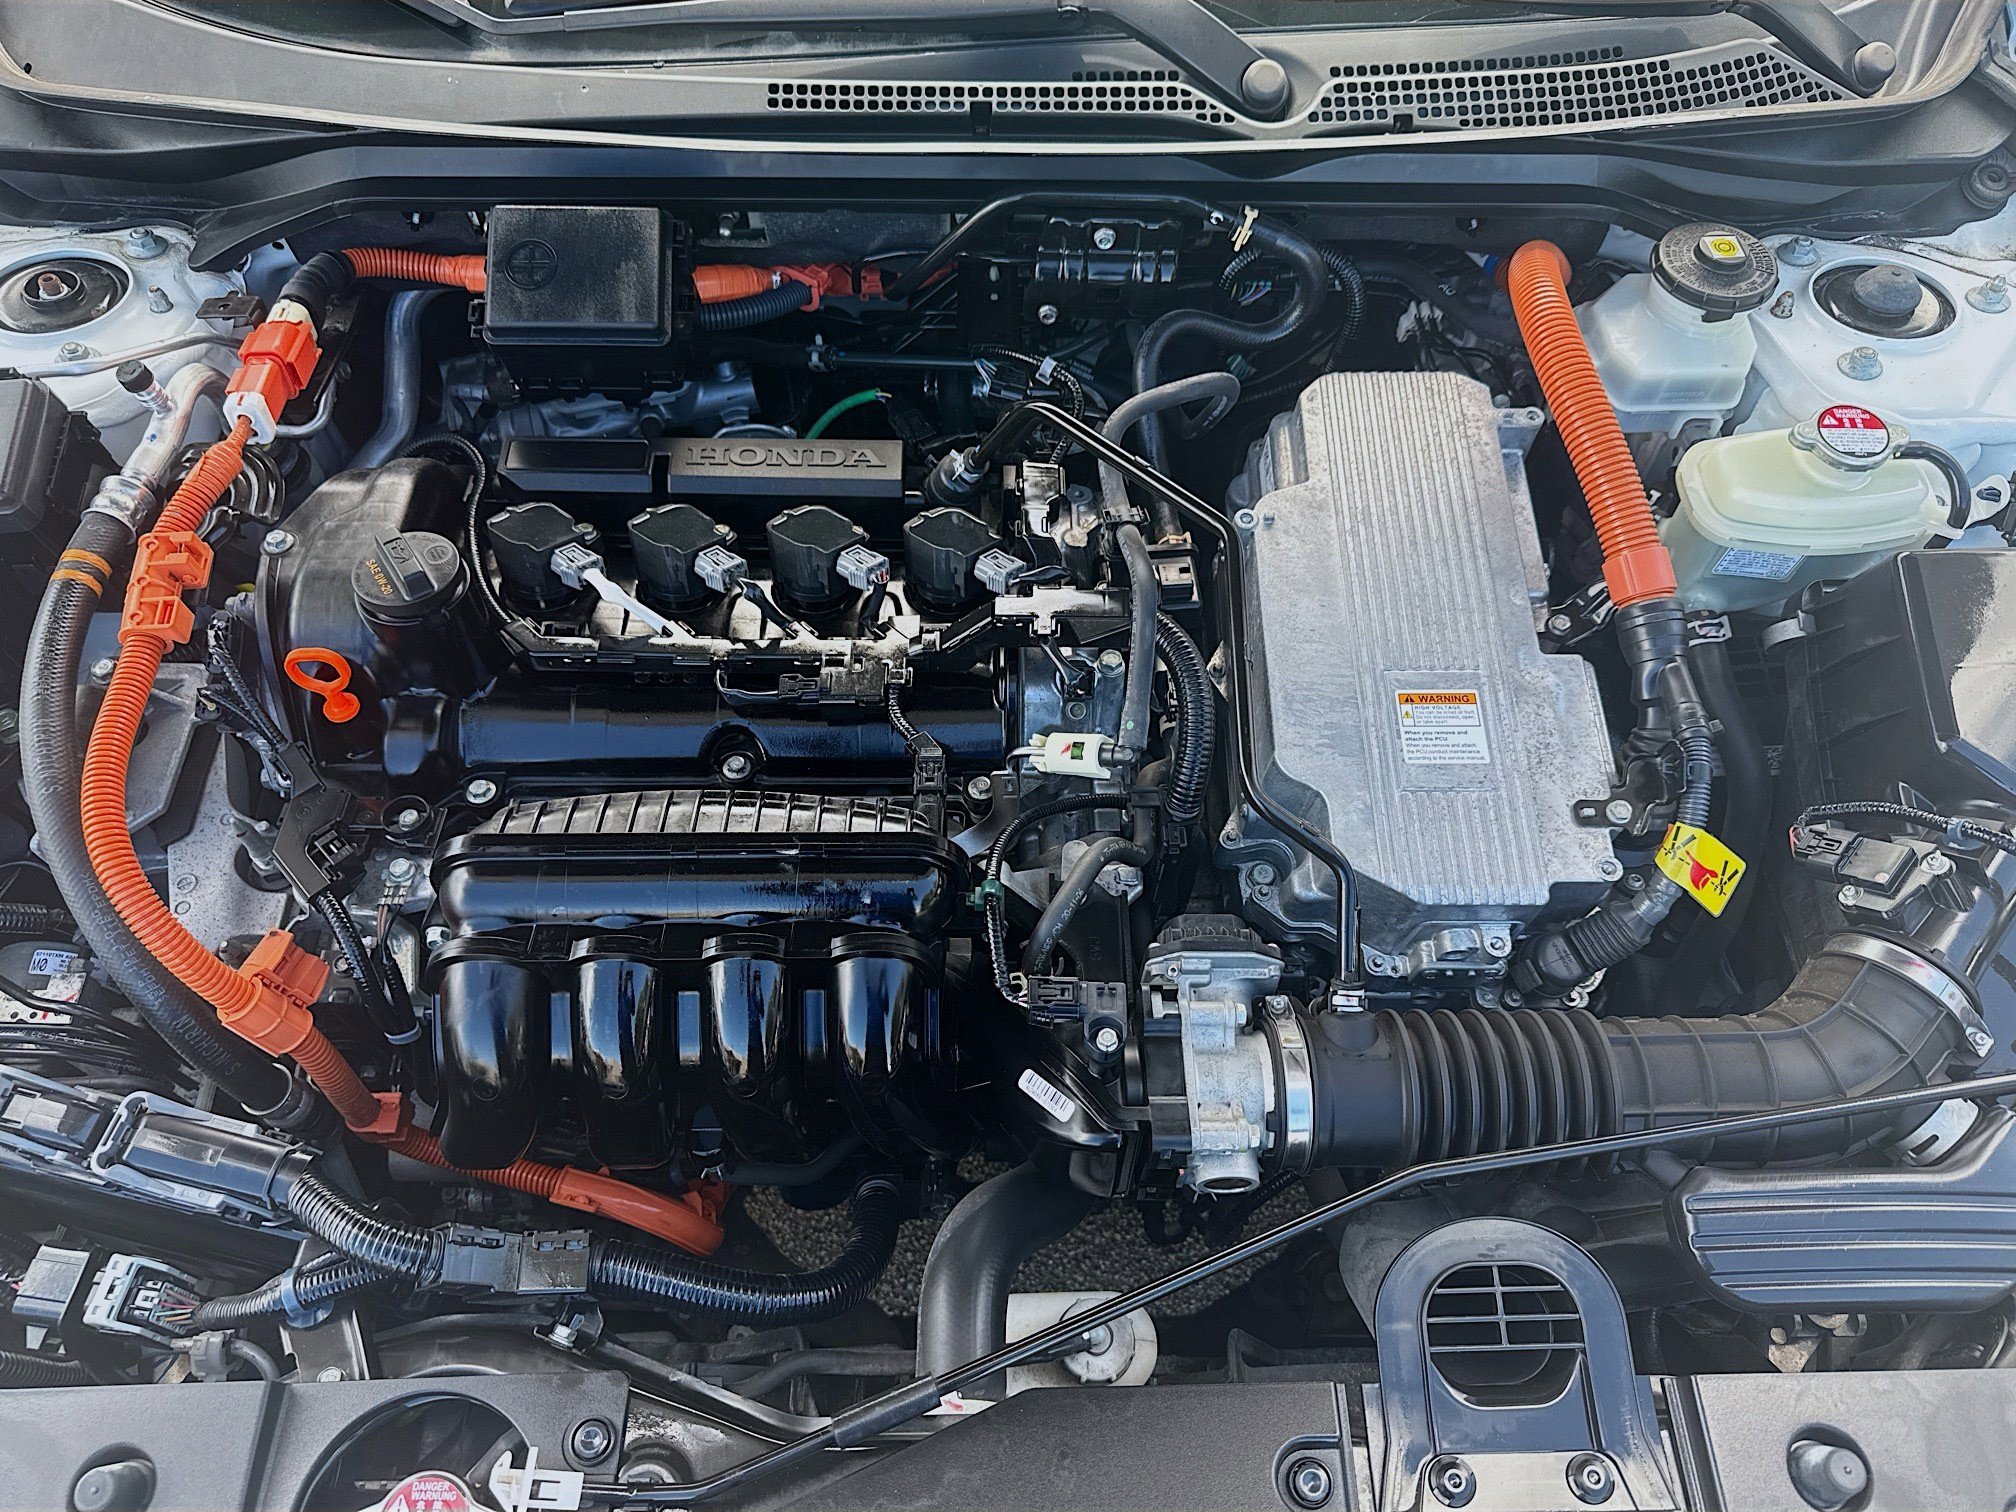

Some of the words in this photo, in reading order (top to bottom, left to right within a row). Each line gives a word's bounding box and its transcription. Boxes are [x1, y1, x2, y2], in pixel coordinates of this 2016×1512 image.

[686, 447, 887, 468] HONDA
[366, 558, 381, 575] SAE
[374, 573, 394, 596] 0W-20
[1418, 694, 1470, 703] WARNING
[171, 1011, 231, 1067] NICHIRIN
[412, 1481, 450, 1491] DANGER
[410, 1490, 457, 1501] WARNUNG
